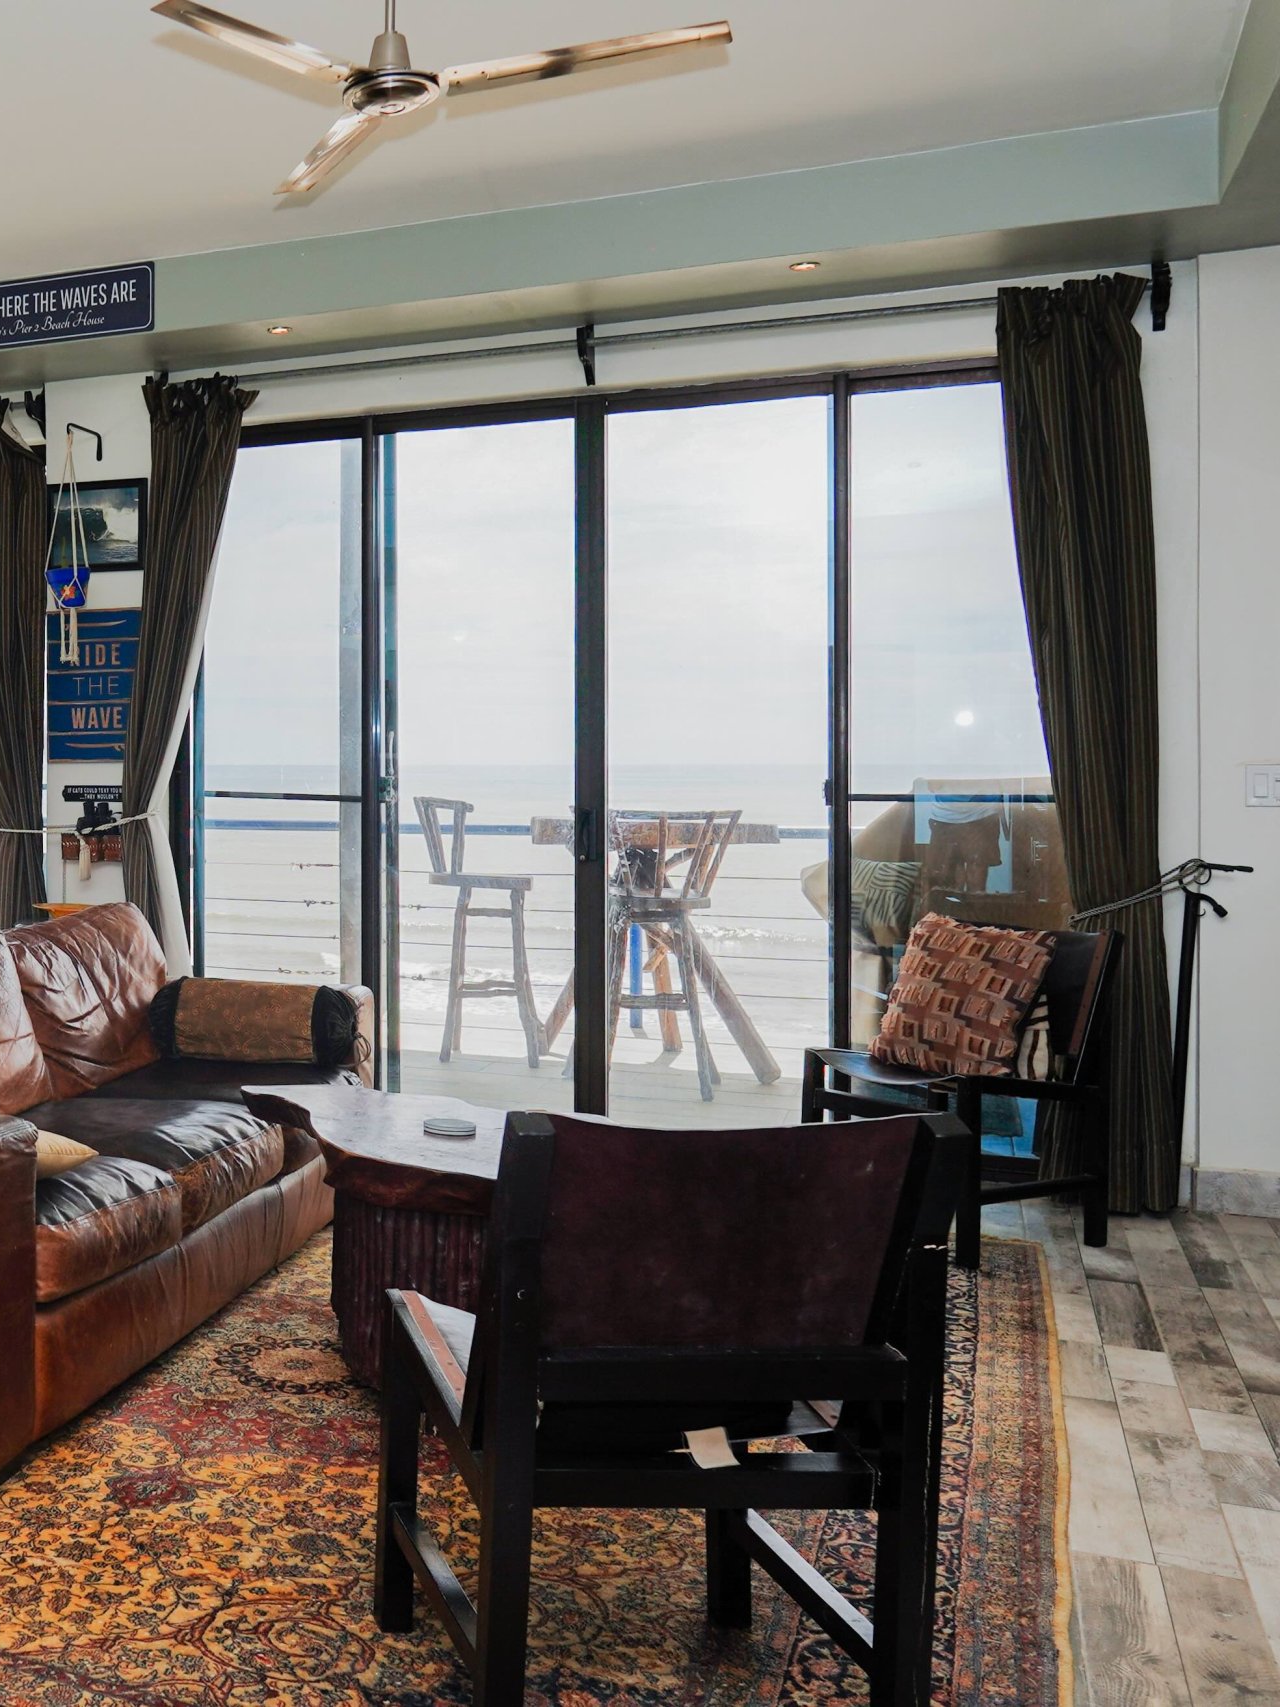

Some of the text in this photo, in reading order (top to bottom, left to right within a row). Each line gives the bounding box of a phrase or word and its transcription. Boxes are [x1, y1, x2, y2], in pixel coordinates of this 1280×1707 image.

[33, 290, 58, 314] THE
[61, 283, 107, 309] WAVES
[111, 279, 137, 303] ARE
[9, 319, 33, 336] Pier
[34, 325, 40, 333] 2
[41, 311, 71, 331] Beach
[72, 309, 105, 327] House
[72, 676, 119, 695] THE
[72, 706, 123, 729] WAVE
